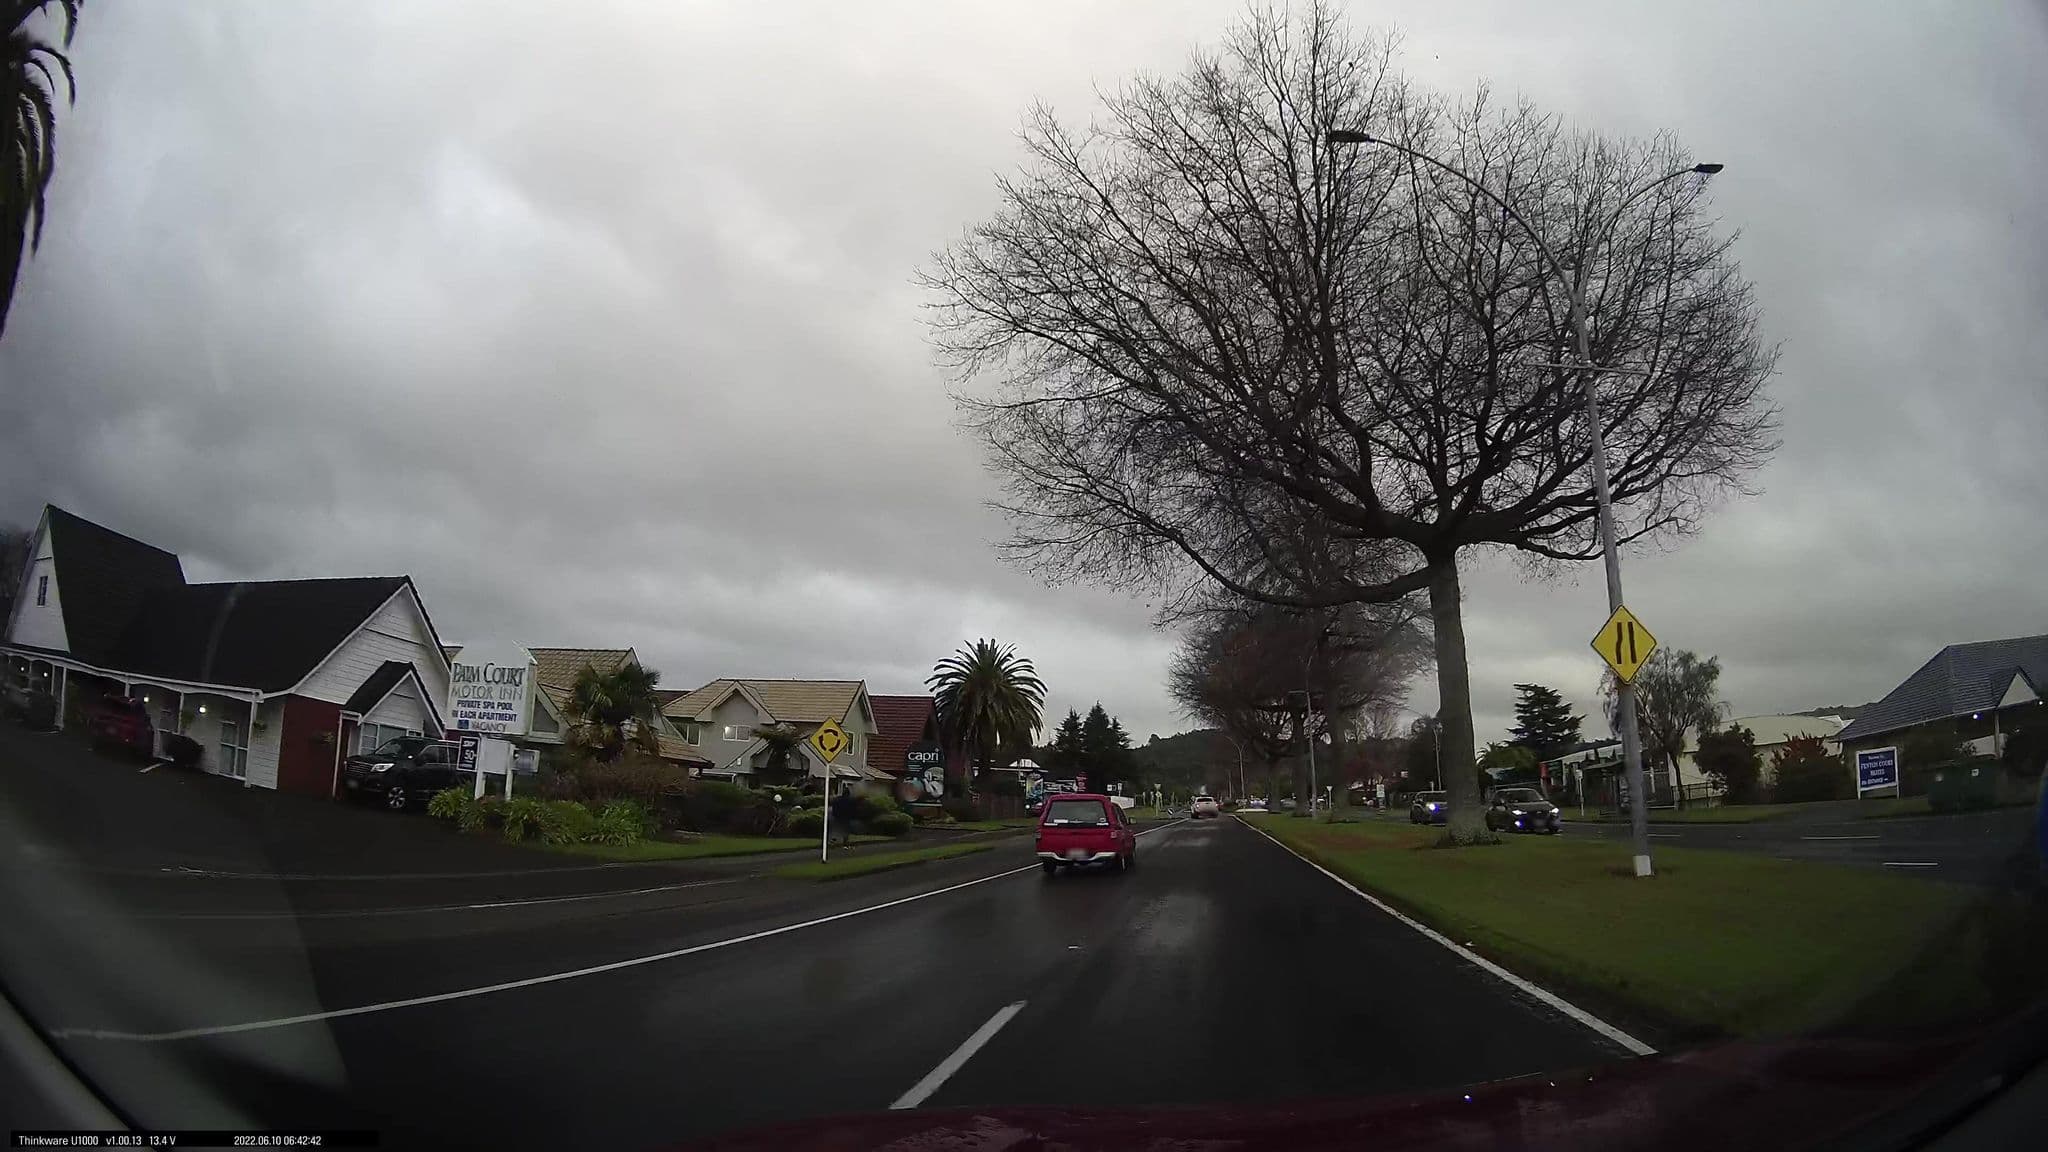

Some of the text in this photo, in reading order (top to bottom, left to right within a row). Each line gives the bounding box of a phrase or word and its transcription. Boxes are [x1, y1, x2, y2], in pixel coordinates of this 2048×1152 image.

[453, 662, 526, 687] PALM COURT
[451, 685, 523, 701] MOTOR INN
[457, 700, 514, 711] PRIVATE SPA POOL
[460, 711, 477, 719] EACH
[478, 712, 518, 722] APARTMENT
[908, 748, 939, 763] capri
